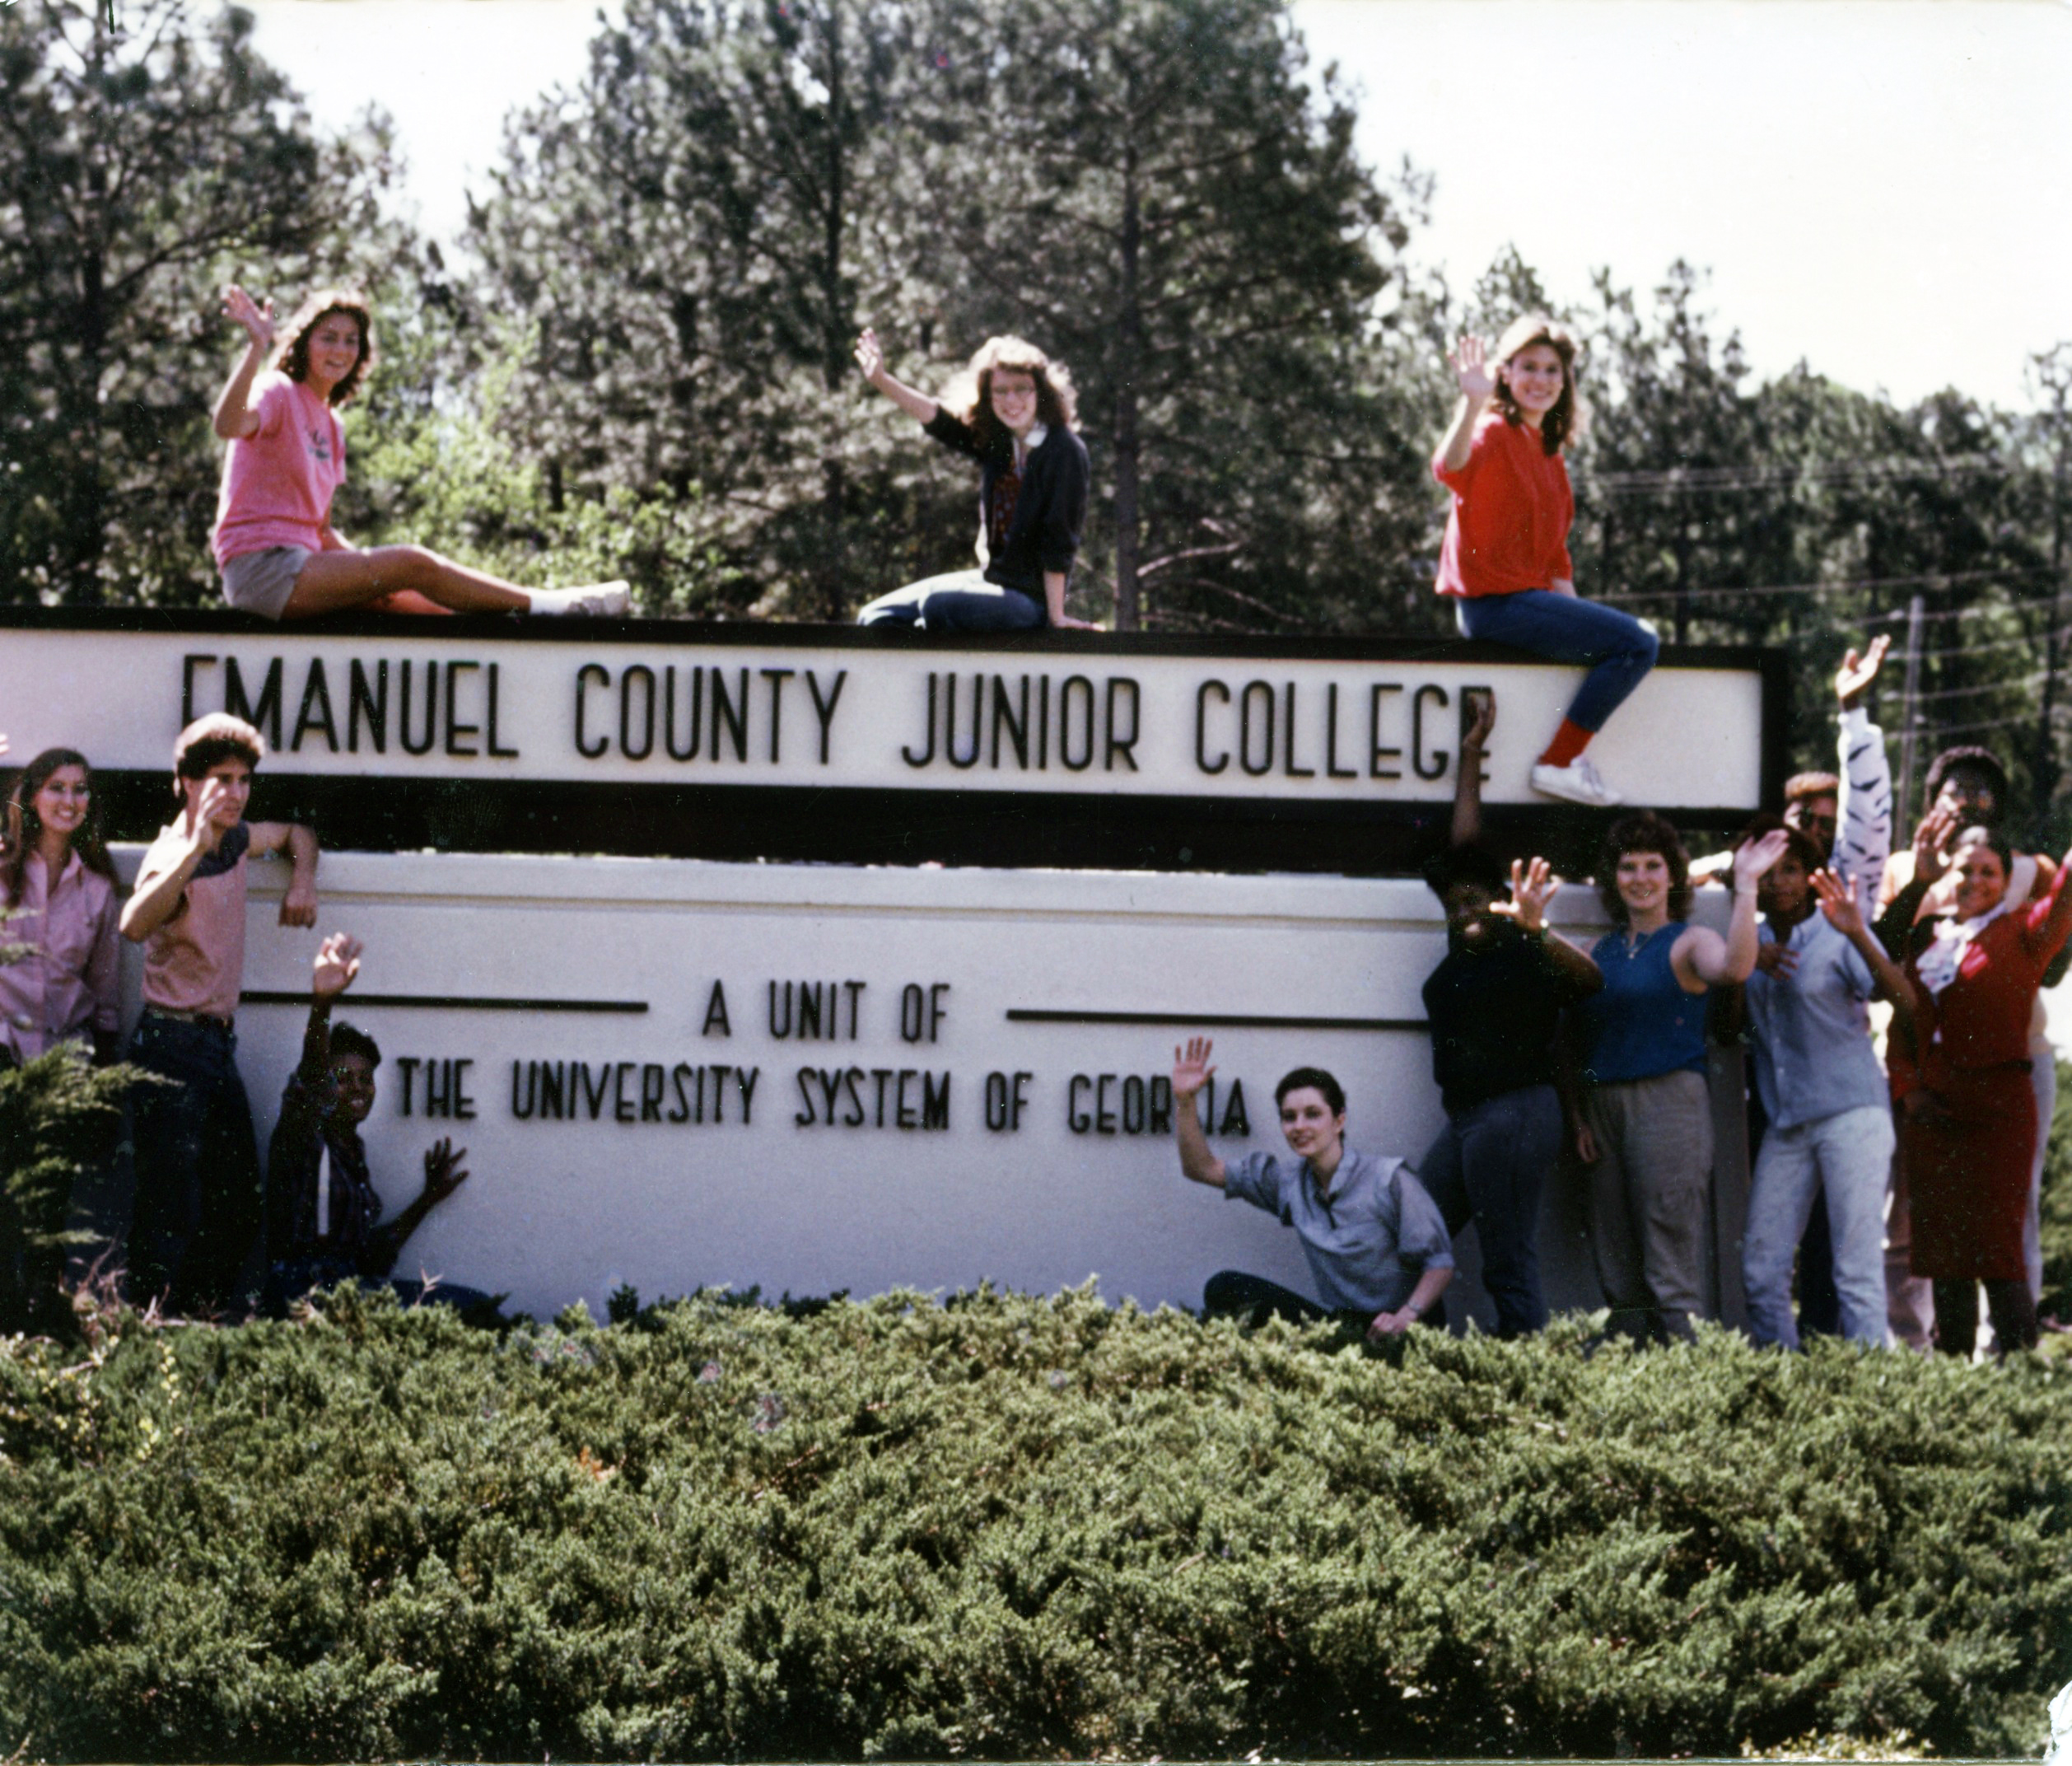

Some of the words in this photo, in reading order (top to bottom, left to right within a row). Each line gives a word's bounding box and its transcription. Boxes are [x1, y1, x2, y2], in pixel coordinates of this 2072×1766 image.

[574, 663, 847, 765] COUNTY
[901, 671, 1141, 772] JUNIOR
[1195, 679, 1492, 782] COLLEGE
[702, 979, 732, 1038] A
[768, 979, 867, 1041] UNIT
[900, 983, 951, 1044] OF
[395, 1057, 478, 1123] THE
[511, 1059, 760, 1126] UNIVERSITY
[794, 1066, 952, 1133] SYSTEM
[984, 1071, 1034, 1133] OF
[1067, 1072, 1252, 1137] GEORIA
